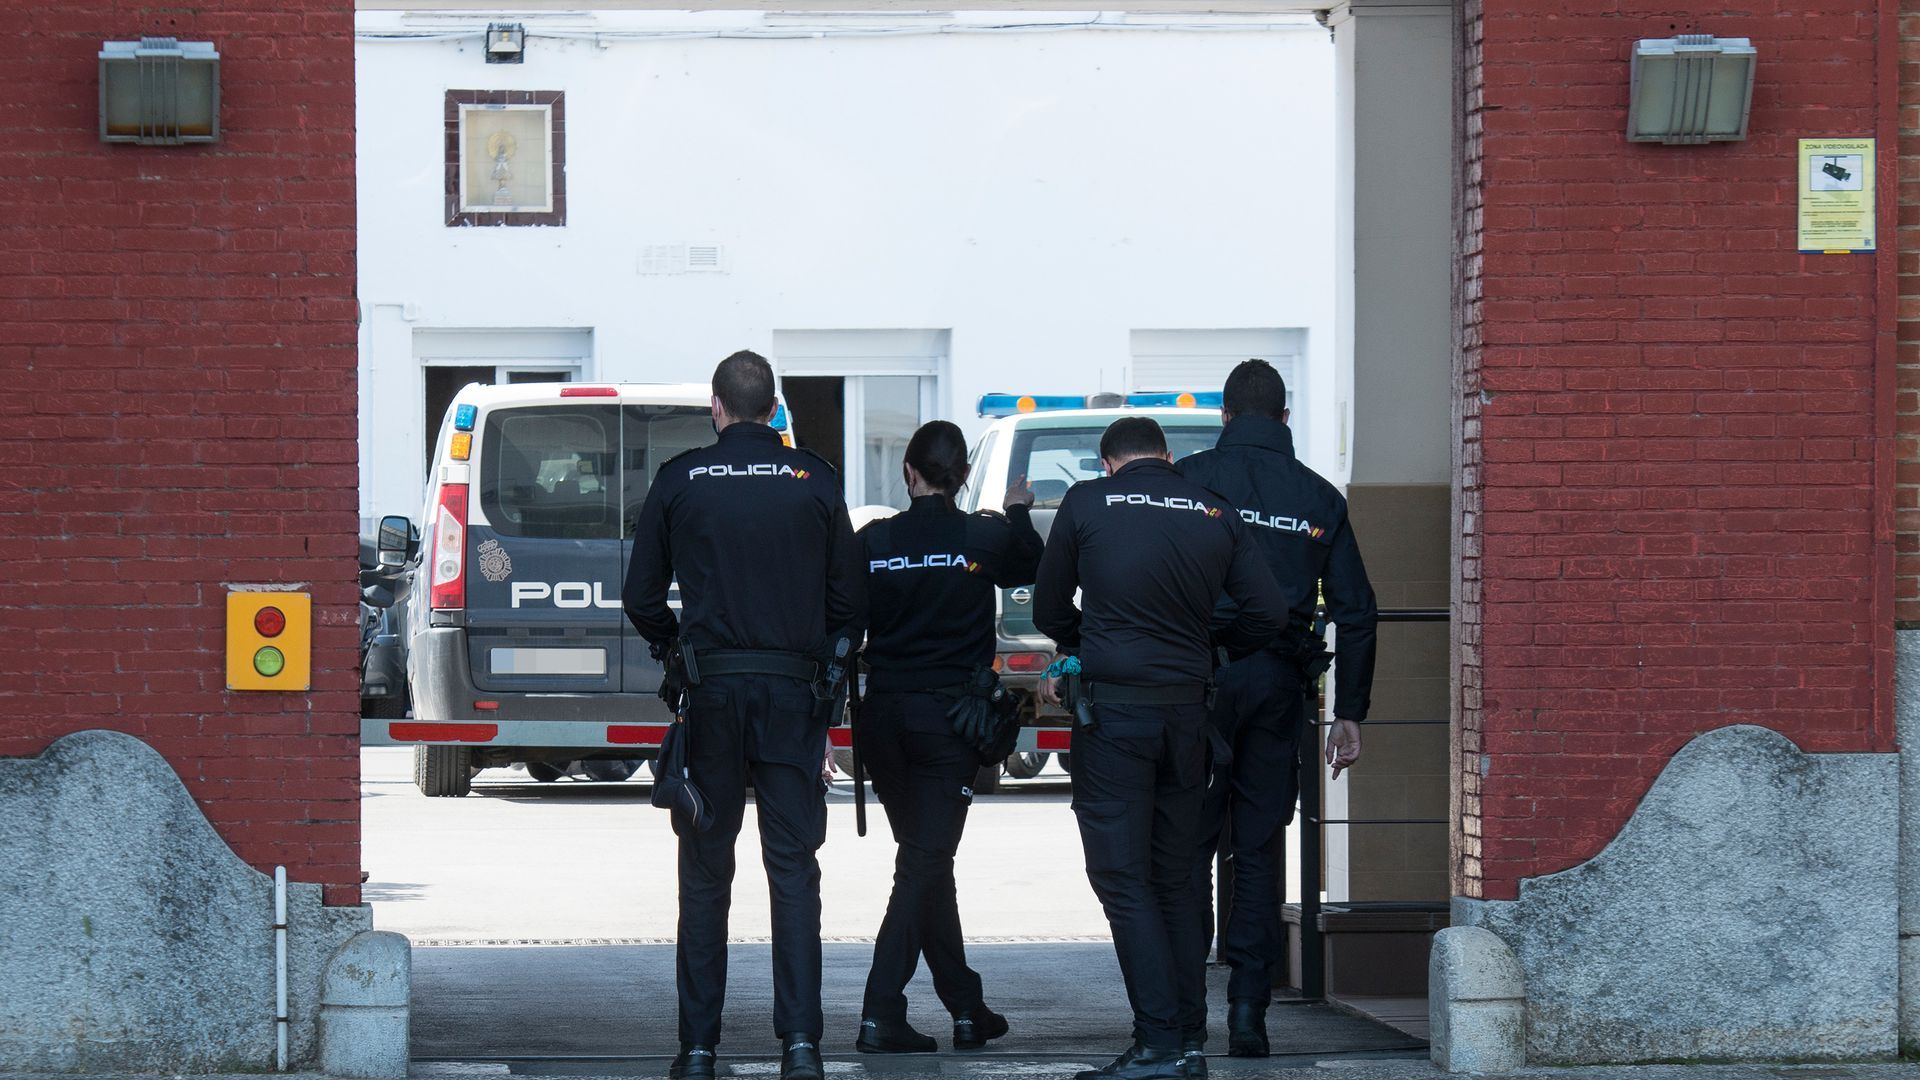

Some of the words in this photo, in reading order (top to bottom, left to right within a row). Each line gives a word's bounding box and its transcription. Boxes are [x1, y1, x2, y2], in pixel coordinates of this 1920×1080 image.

[689, 464, 796, 480] POLICIA
[1105, 494, 1209, 514] POLICIA
[1236, 508, 1311, 534] OLICIA
[869, 554, 968, 573] POLICIA
